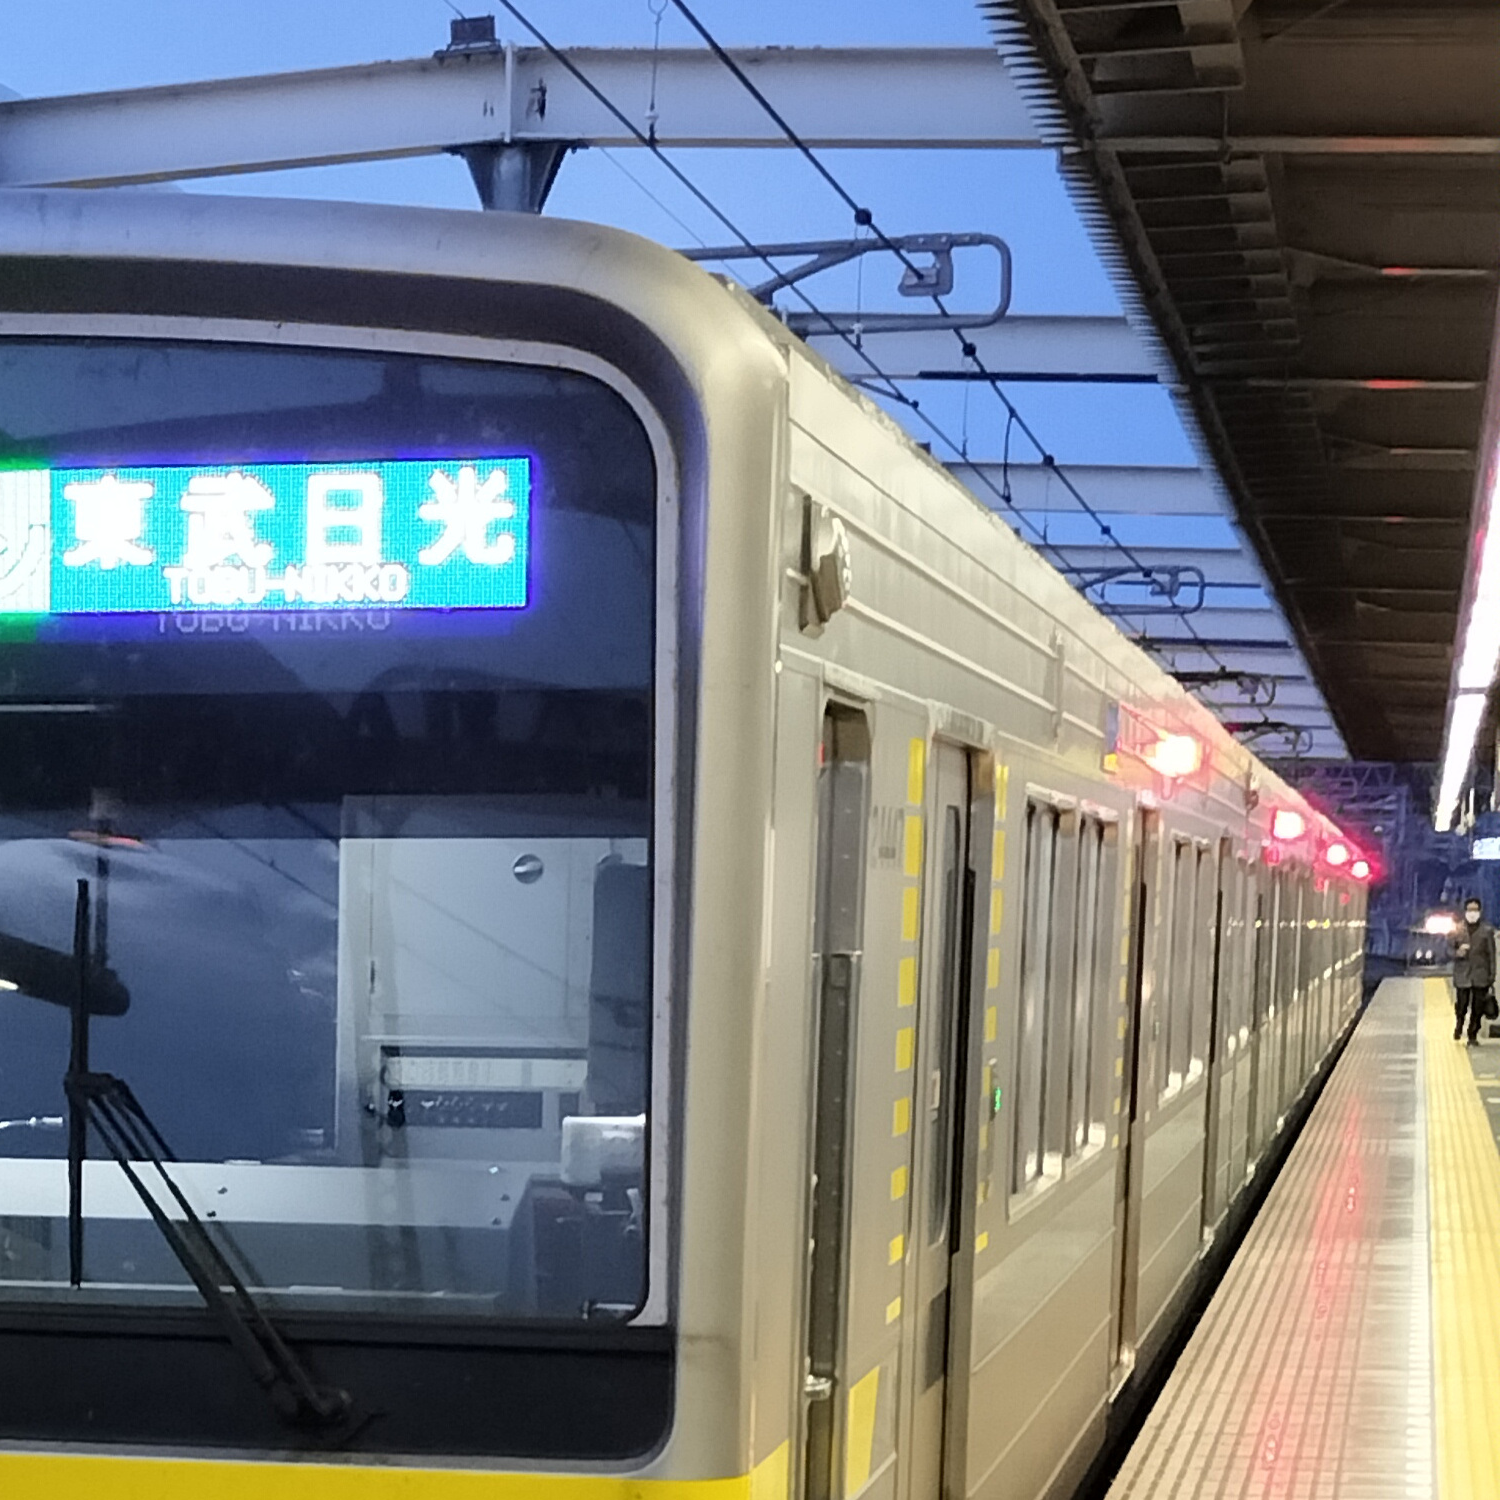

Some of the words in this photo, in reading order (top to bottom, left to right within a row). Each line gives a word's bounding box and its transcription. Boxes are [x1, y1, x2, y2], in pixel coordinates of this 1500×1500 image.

[62, 466, 516, 570] 東武日光
[162, 562, 413, 605] TOBU-NIKKO
